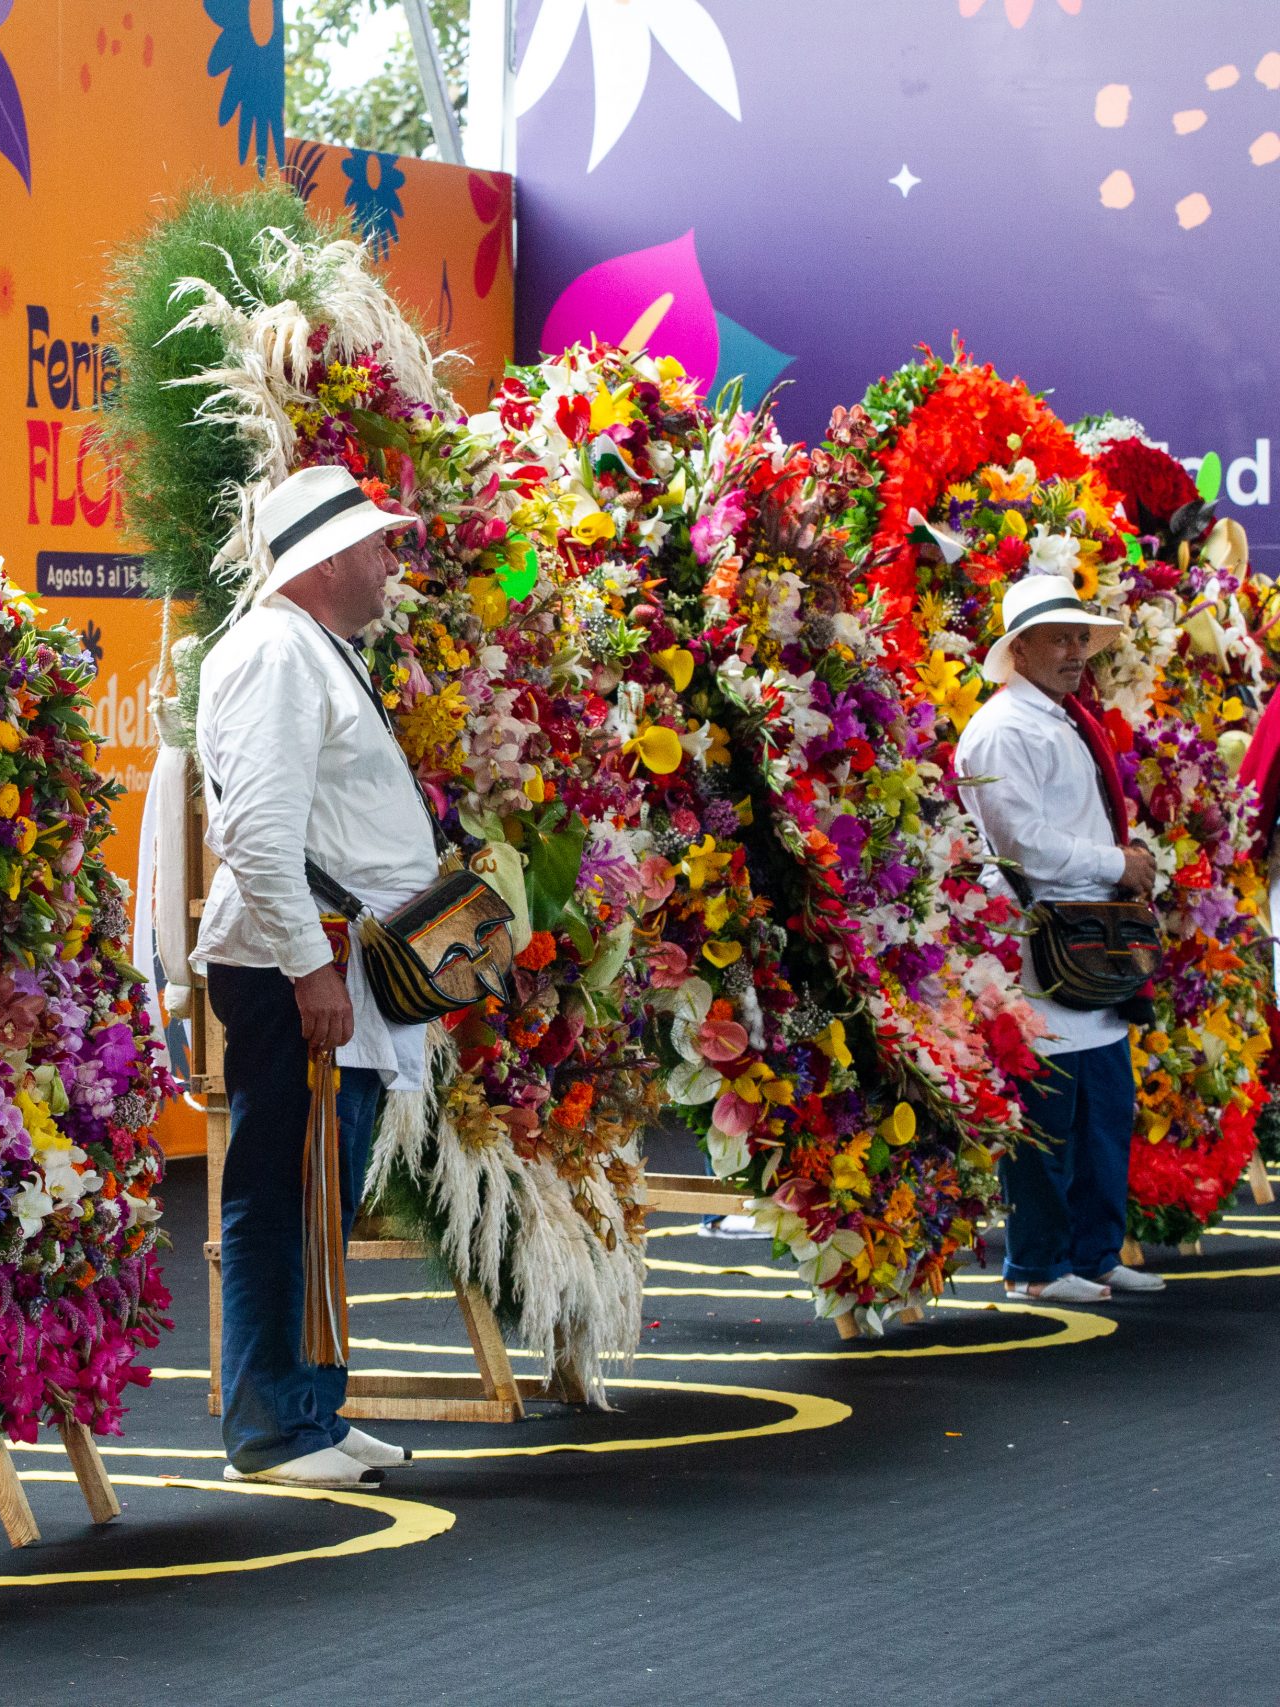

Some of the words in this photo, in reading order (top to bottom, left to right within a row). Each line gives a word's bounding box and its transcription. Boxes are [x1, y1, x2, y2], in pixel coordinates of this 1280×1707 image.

[46, 564, 93, 591] Agosto
[96, 565, 105, 587] 5
[108, 566, 120, 588] al
